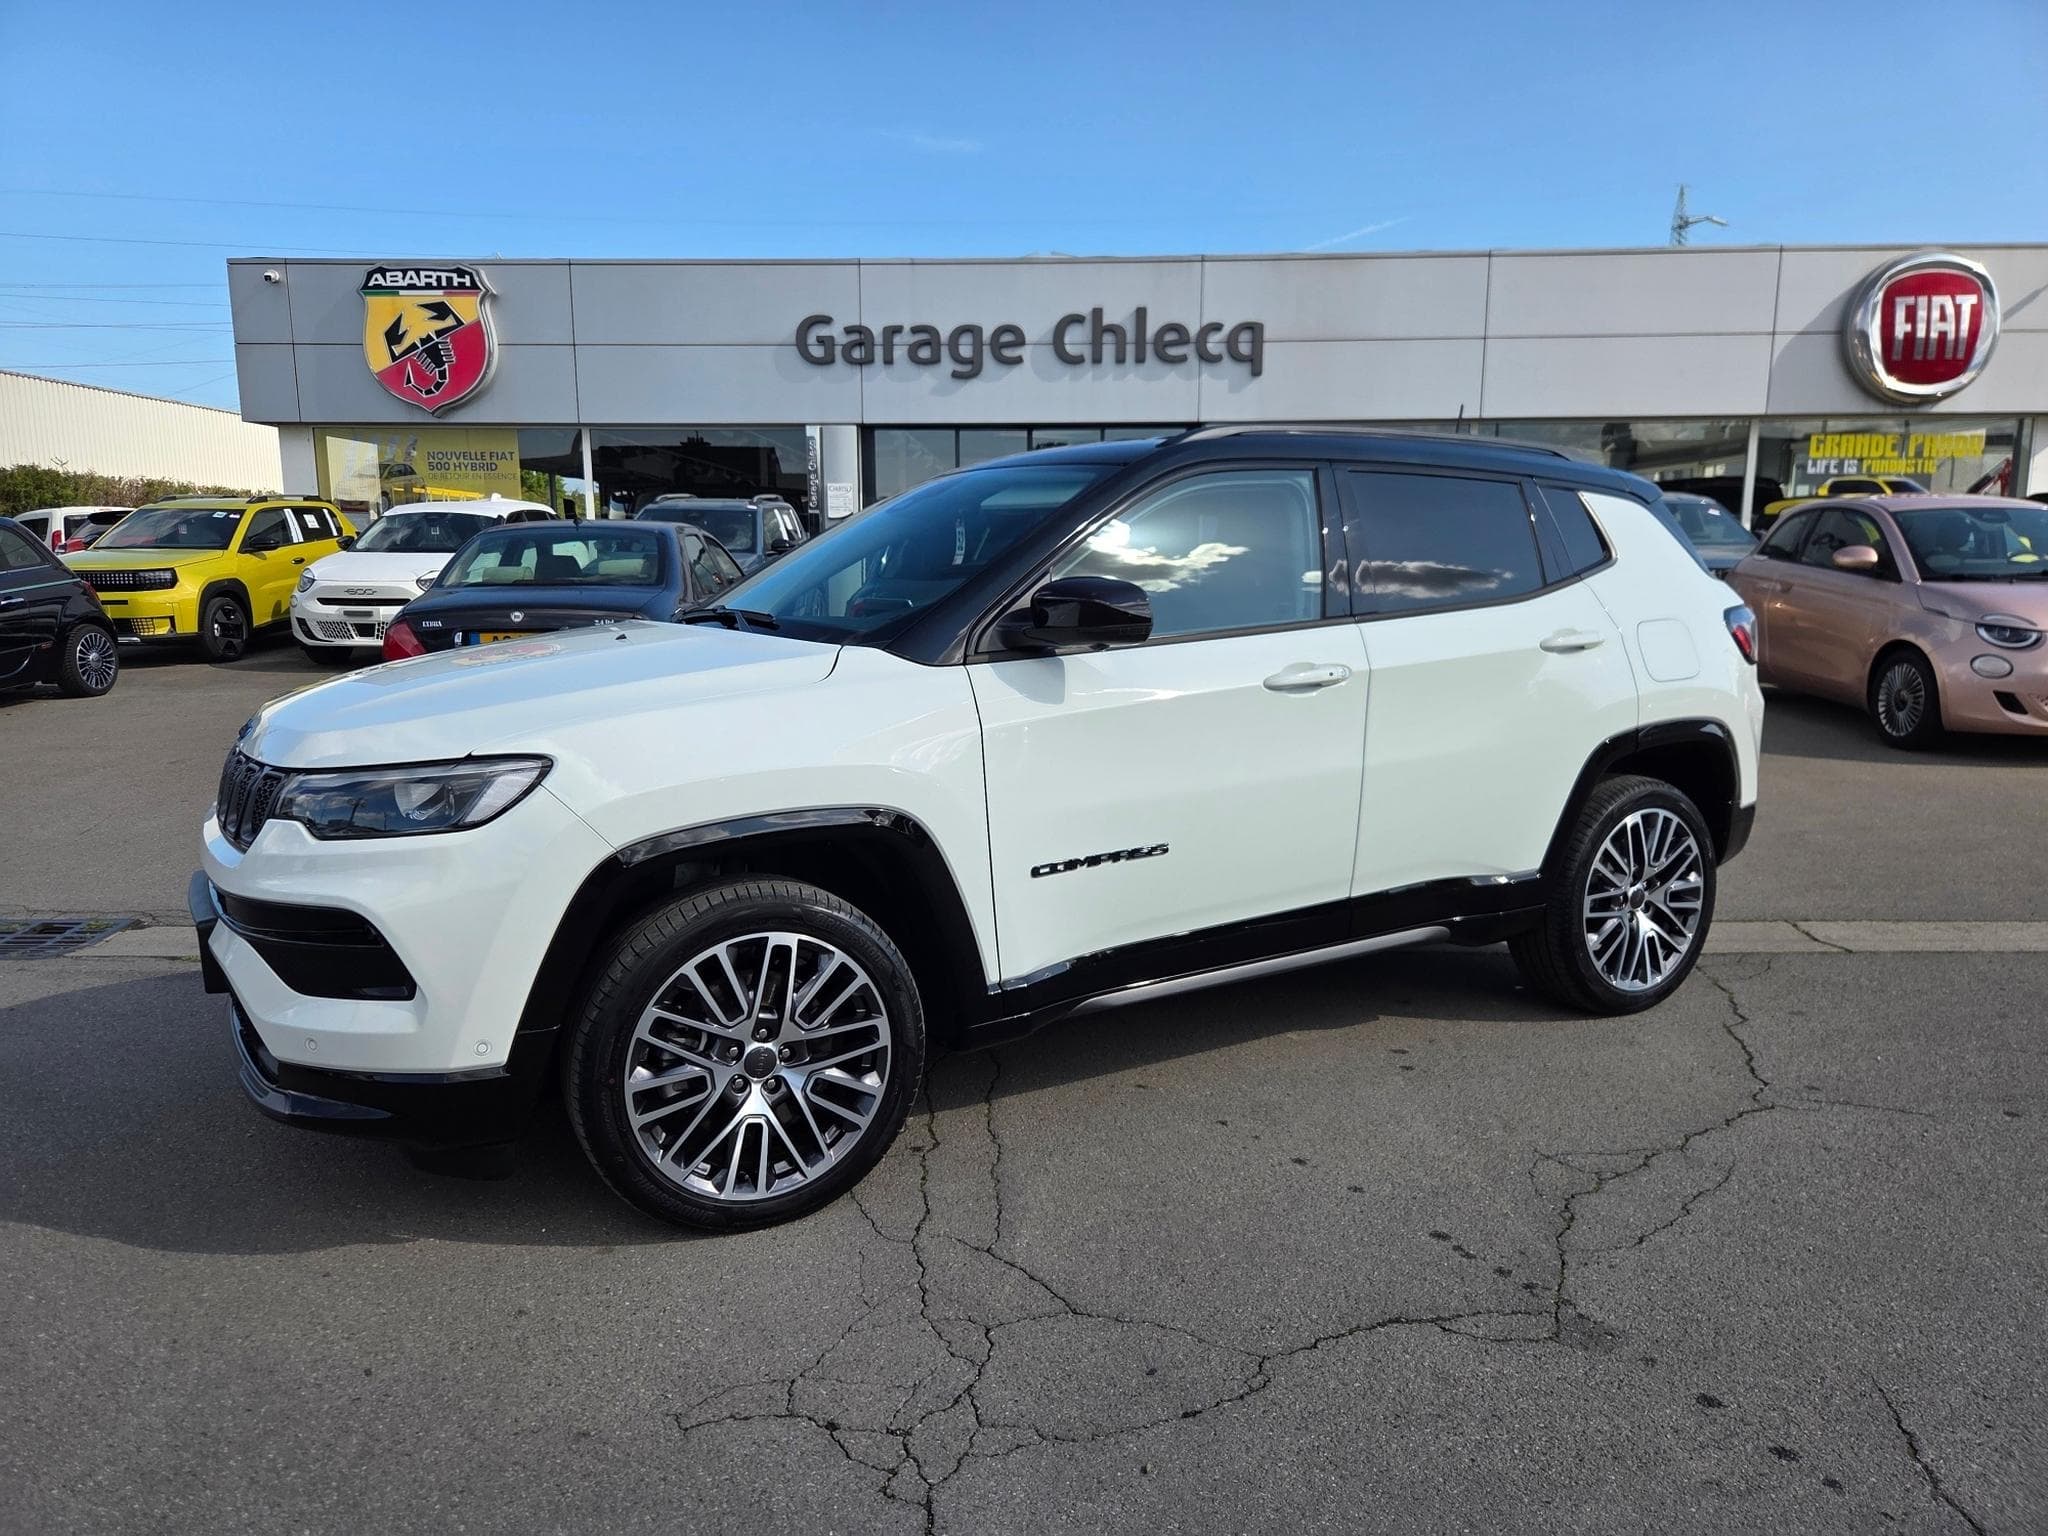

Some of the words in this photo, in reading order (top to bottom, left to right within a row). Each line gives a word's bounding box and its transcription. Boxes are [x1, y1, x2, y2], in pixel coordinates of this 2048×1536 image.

[367, 270, 471, 287] ABARTH
[1891, 293, 1978, 361] FIAT
[795, 314, 1026, 379] Garage
[1053, 307, 1264, 377] Chlecq
[427, 451, 487, 461] NOUVELLE
[489, 451, 515, 461] FIAT
[1808, 433, 1900, 458] GRANDE
[428, 461, 451, 471] 500
[453, 461, 498, 472] HYBRID
[484, 472, 518, 480] ESSENCE
[1806, 458, 1840, 474] LIFE
[1843, 459, 1859, 474] IS
[810, 473, 819, 507] Garage
[1030, 842, 1169, 878] COMPASS
